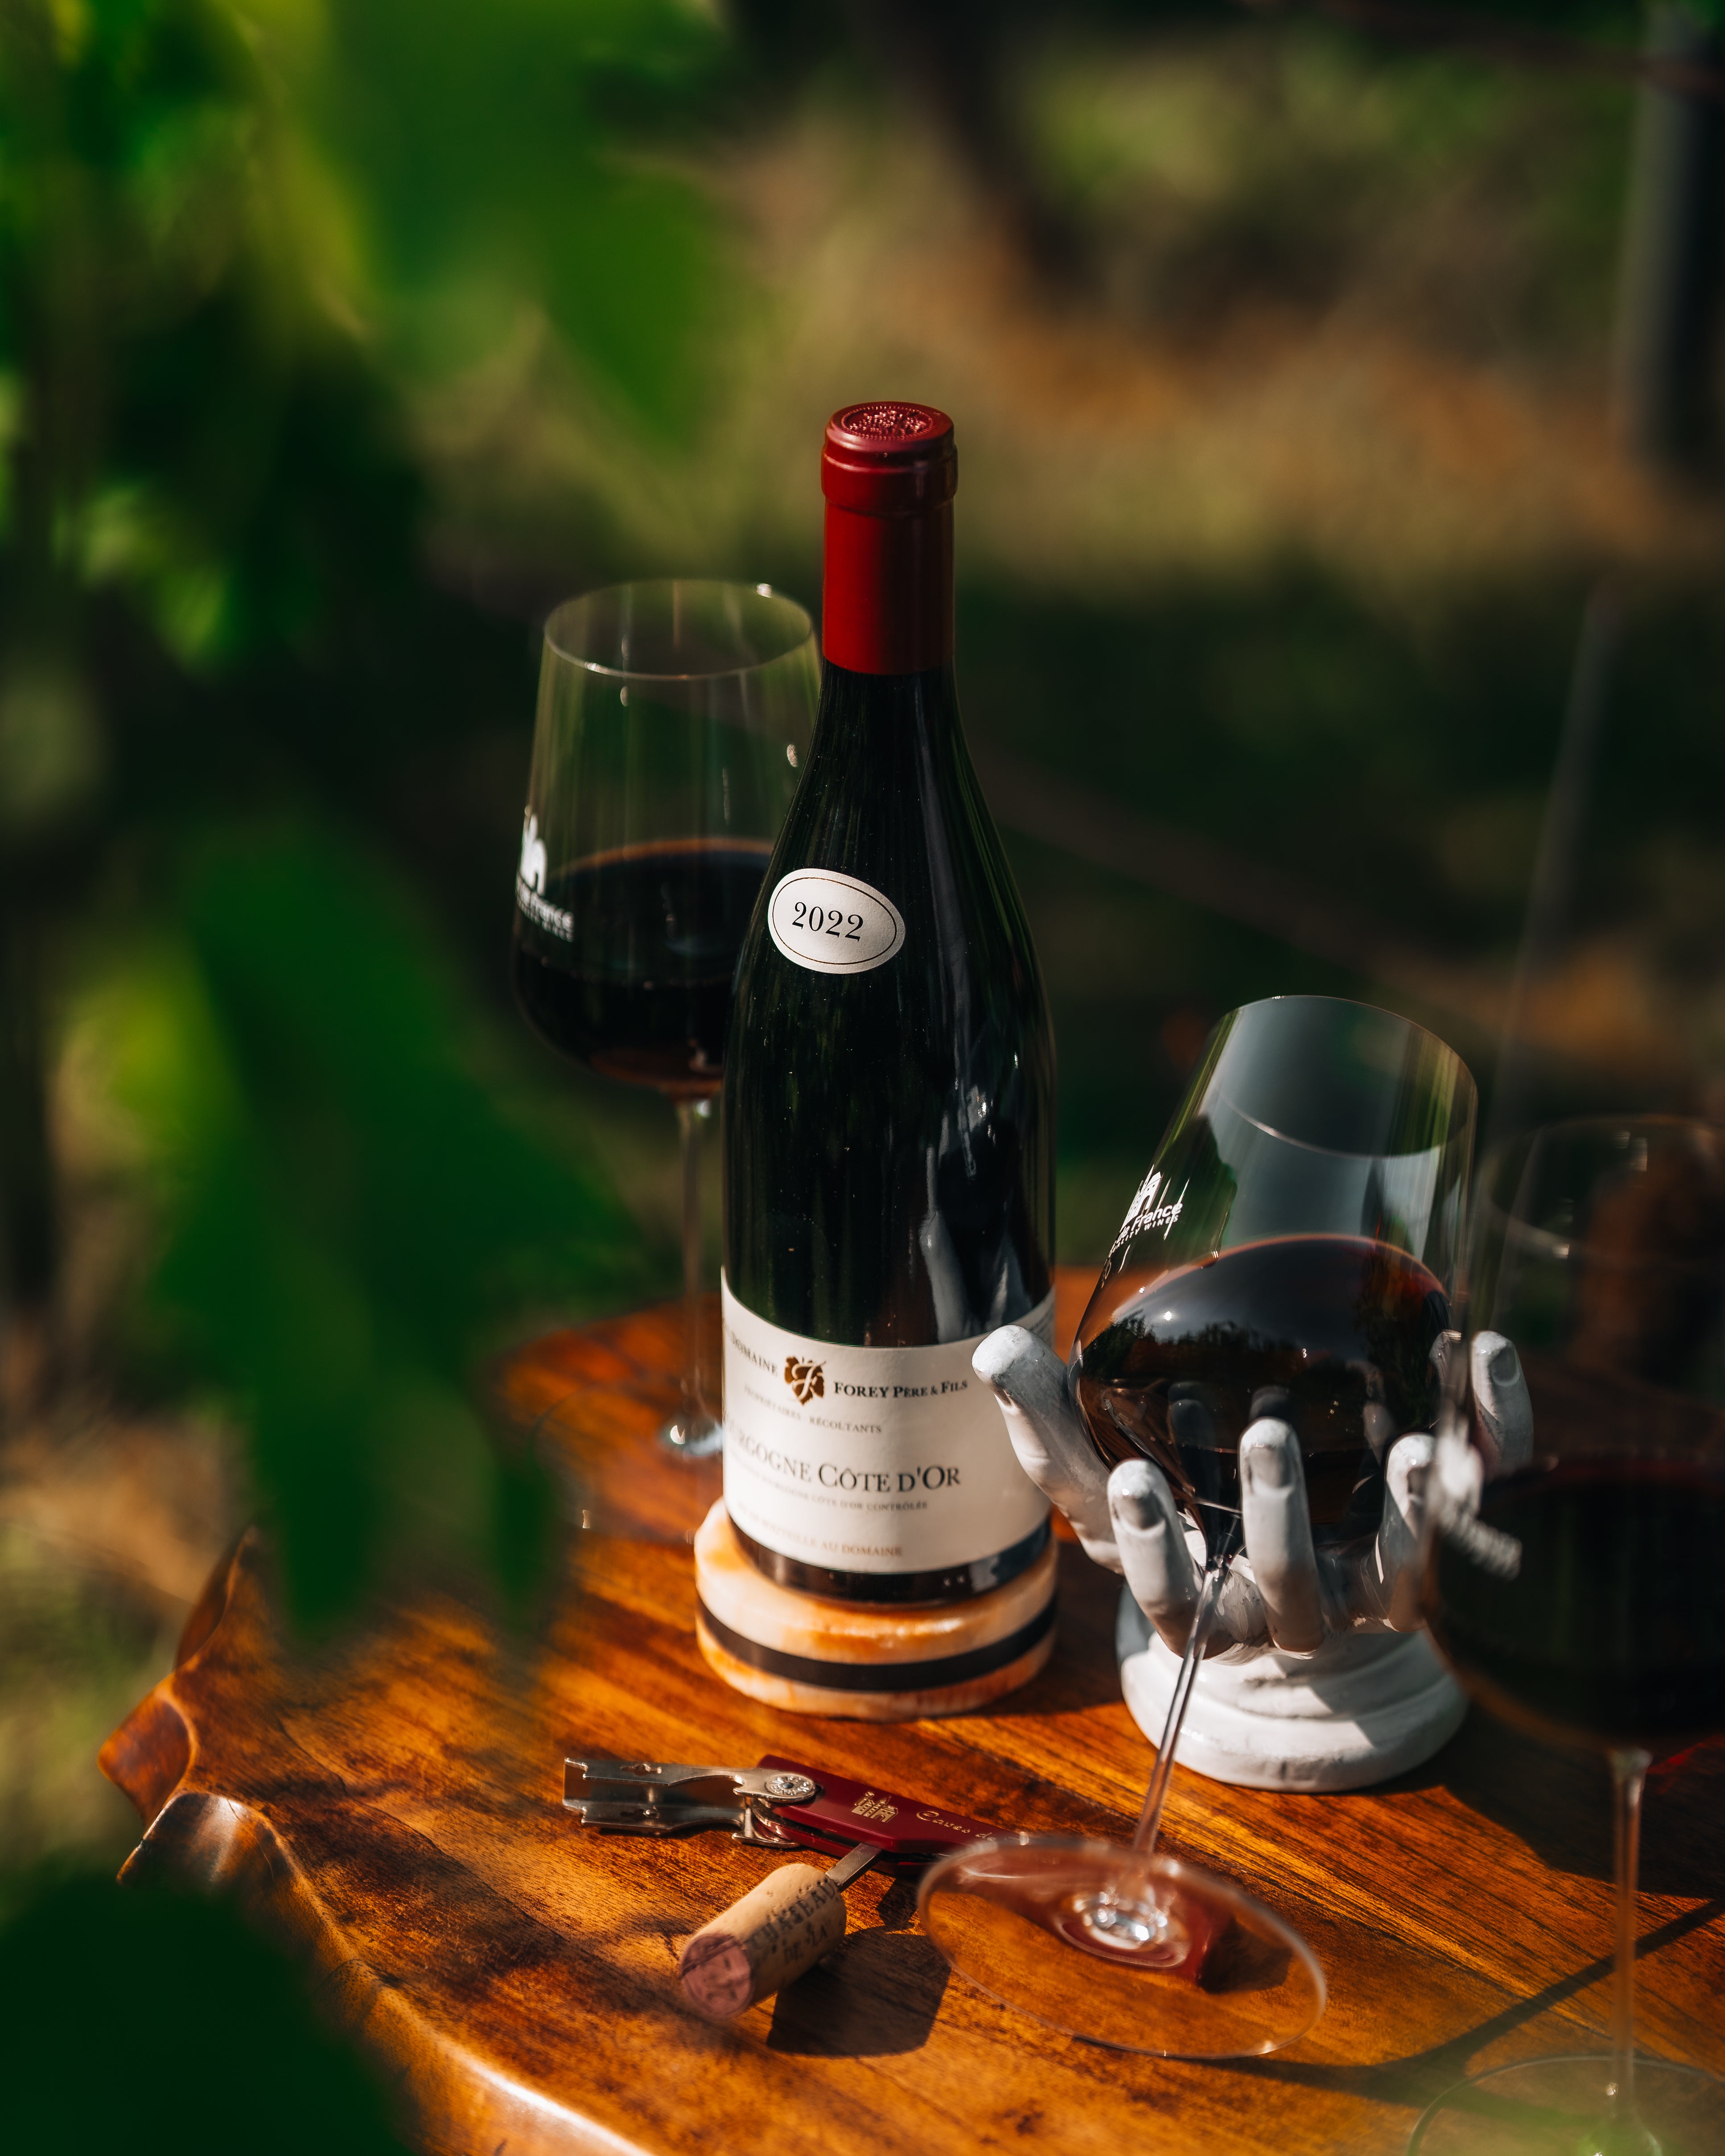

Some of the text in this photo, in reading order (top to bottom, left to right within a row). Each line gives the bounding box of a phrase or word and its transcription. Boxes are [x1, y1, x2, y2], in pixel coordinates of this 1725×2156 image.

[792, 902, 863, 942] 2022
[1131, 1203, 1183, 1231] France
[1144, 1214, 1179, 1231] WINES
[834, 1382, 889, 1398] FOREY
[930, 1385, 938, 1395] &
[941, 1380, 968, 1394] FILS
[818, 1463, 891, 1492] CÔTE
[897, 1465, 960, 1492] D'OR
[842, 1543, 902, 1557] DOMAINE
[916, 1810, 970, 1833] Caves
